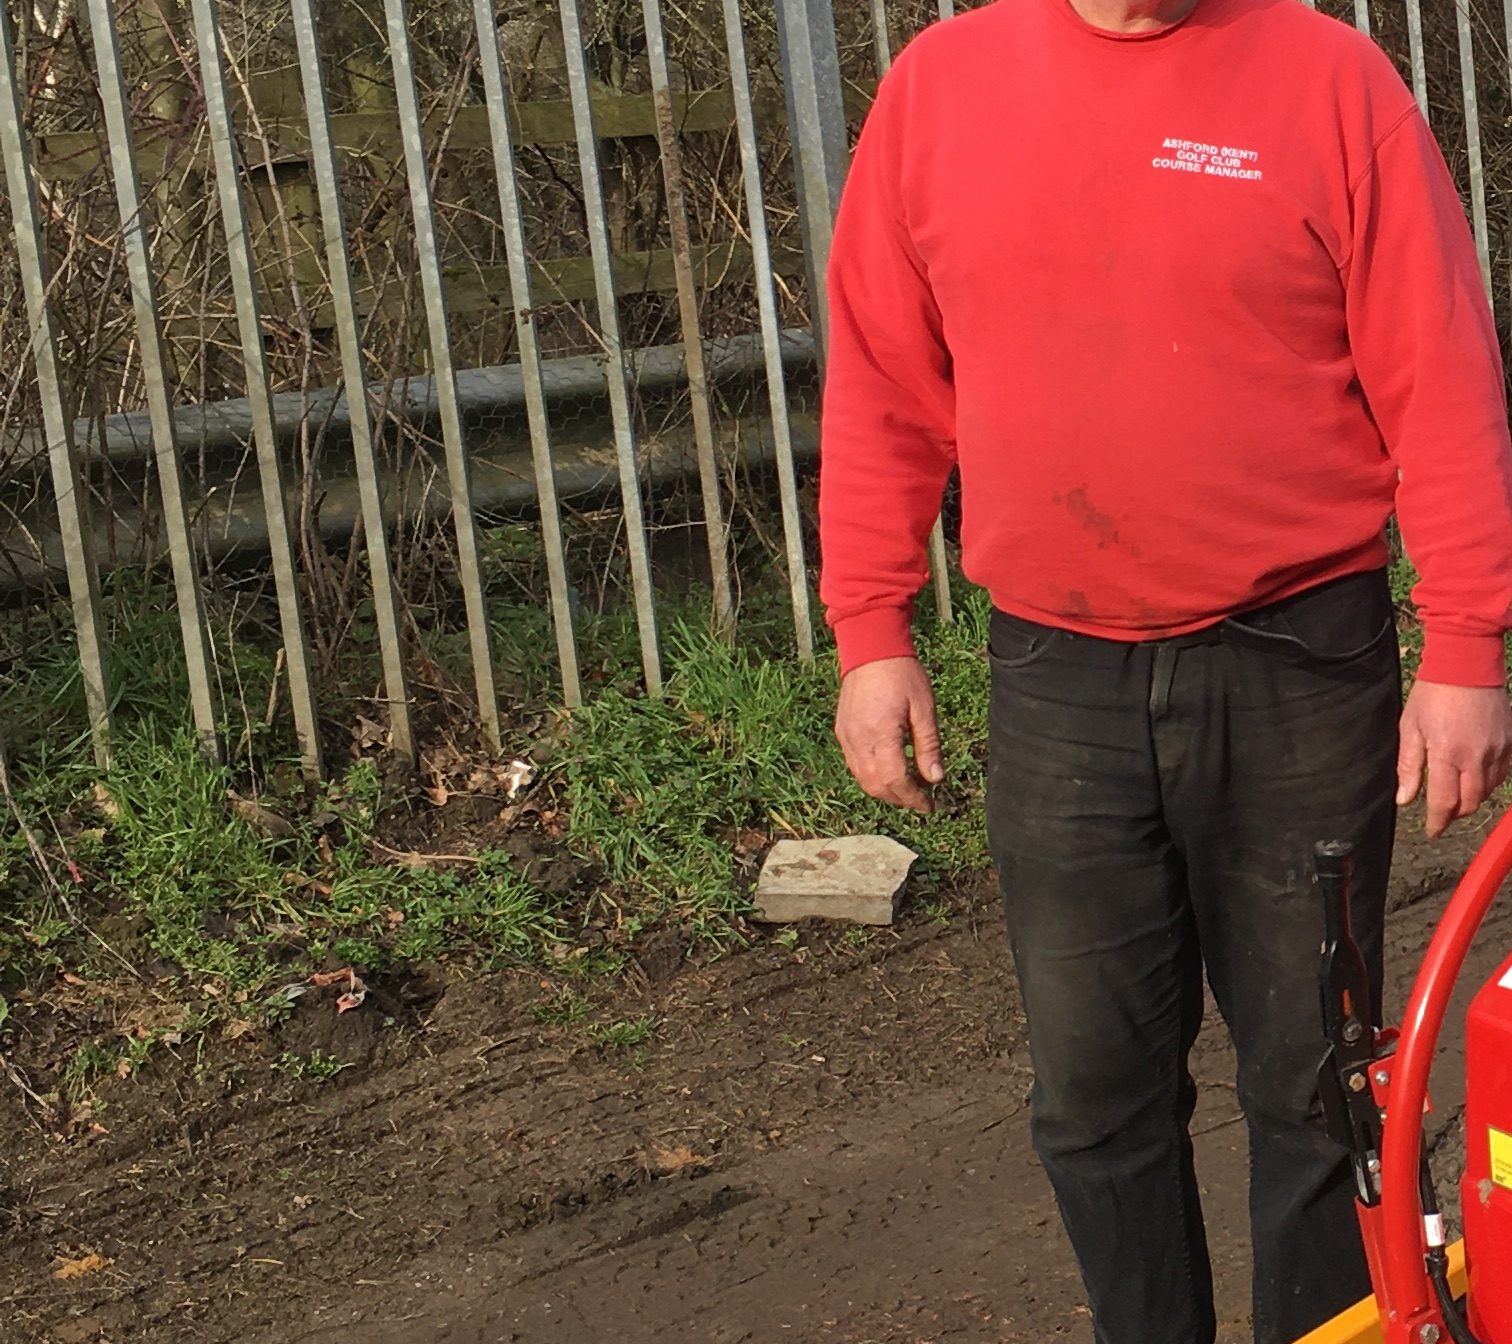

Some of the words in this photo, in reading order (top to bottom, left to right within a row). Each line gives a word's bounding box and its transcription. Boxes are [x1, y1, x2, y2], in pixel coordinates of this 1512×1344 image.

[1162, 137, 1218, 155] ASHFORD
[1221, 146, 1258, 162] (KENT)
[1176, 150, 1208, 163] GOLF
[1210, 155, 1241, 168] CLUB
[1152, 157, 1201, 173] COURSE
[1204, 164, 1262, 180] MANAGER
